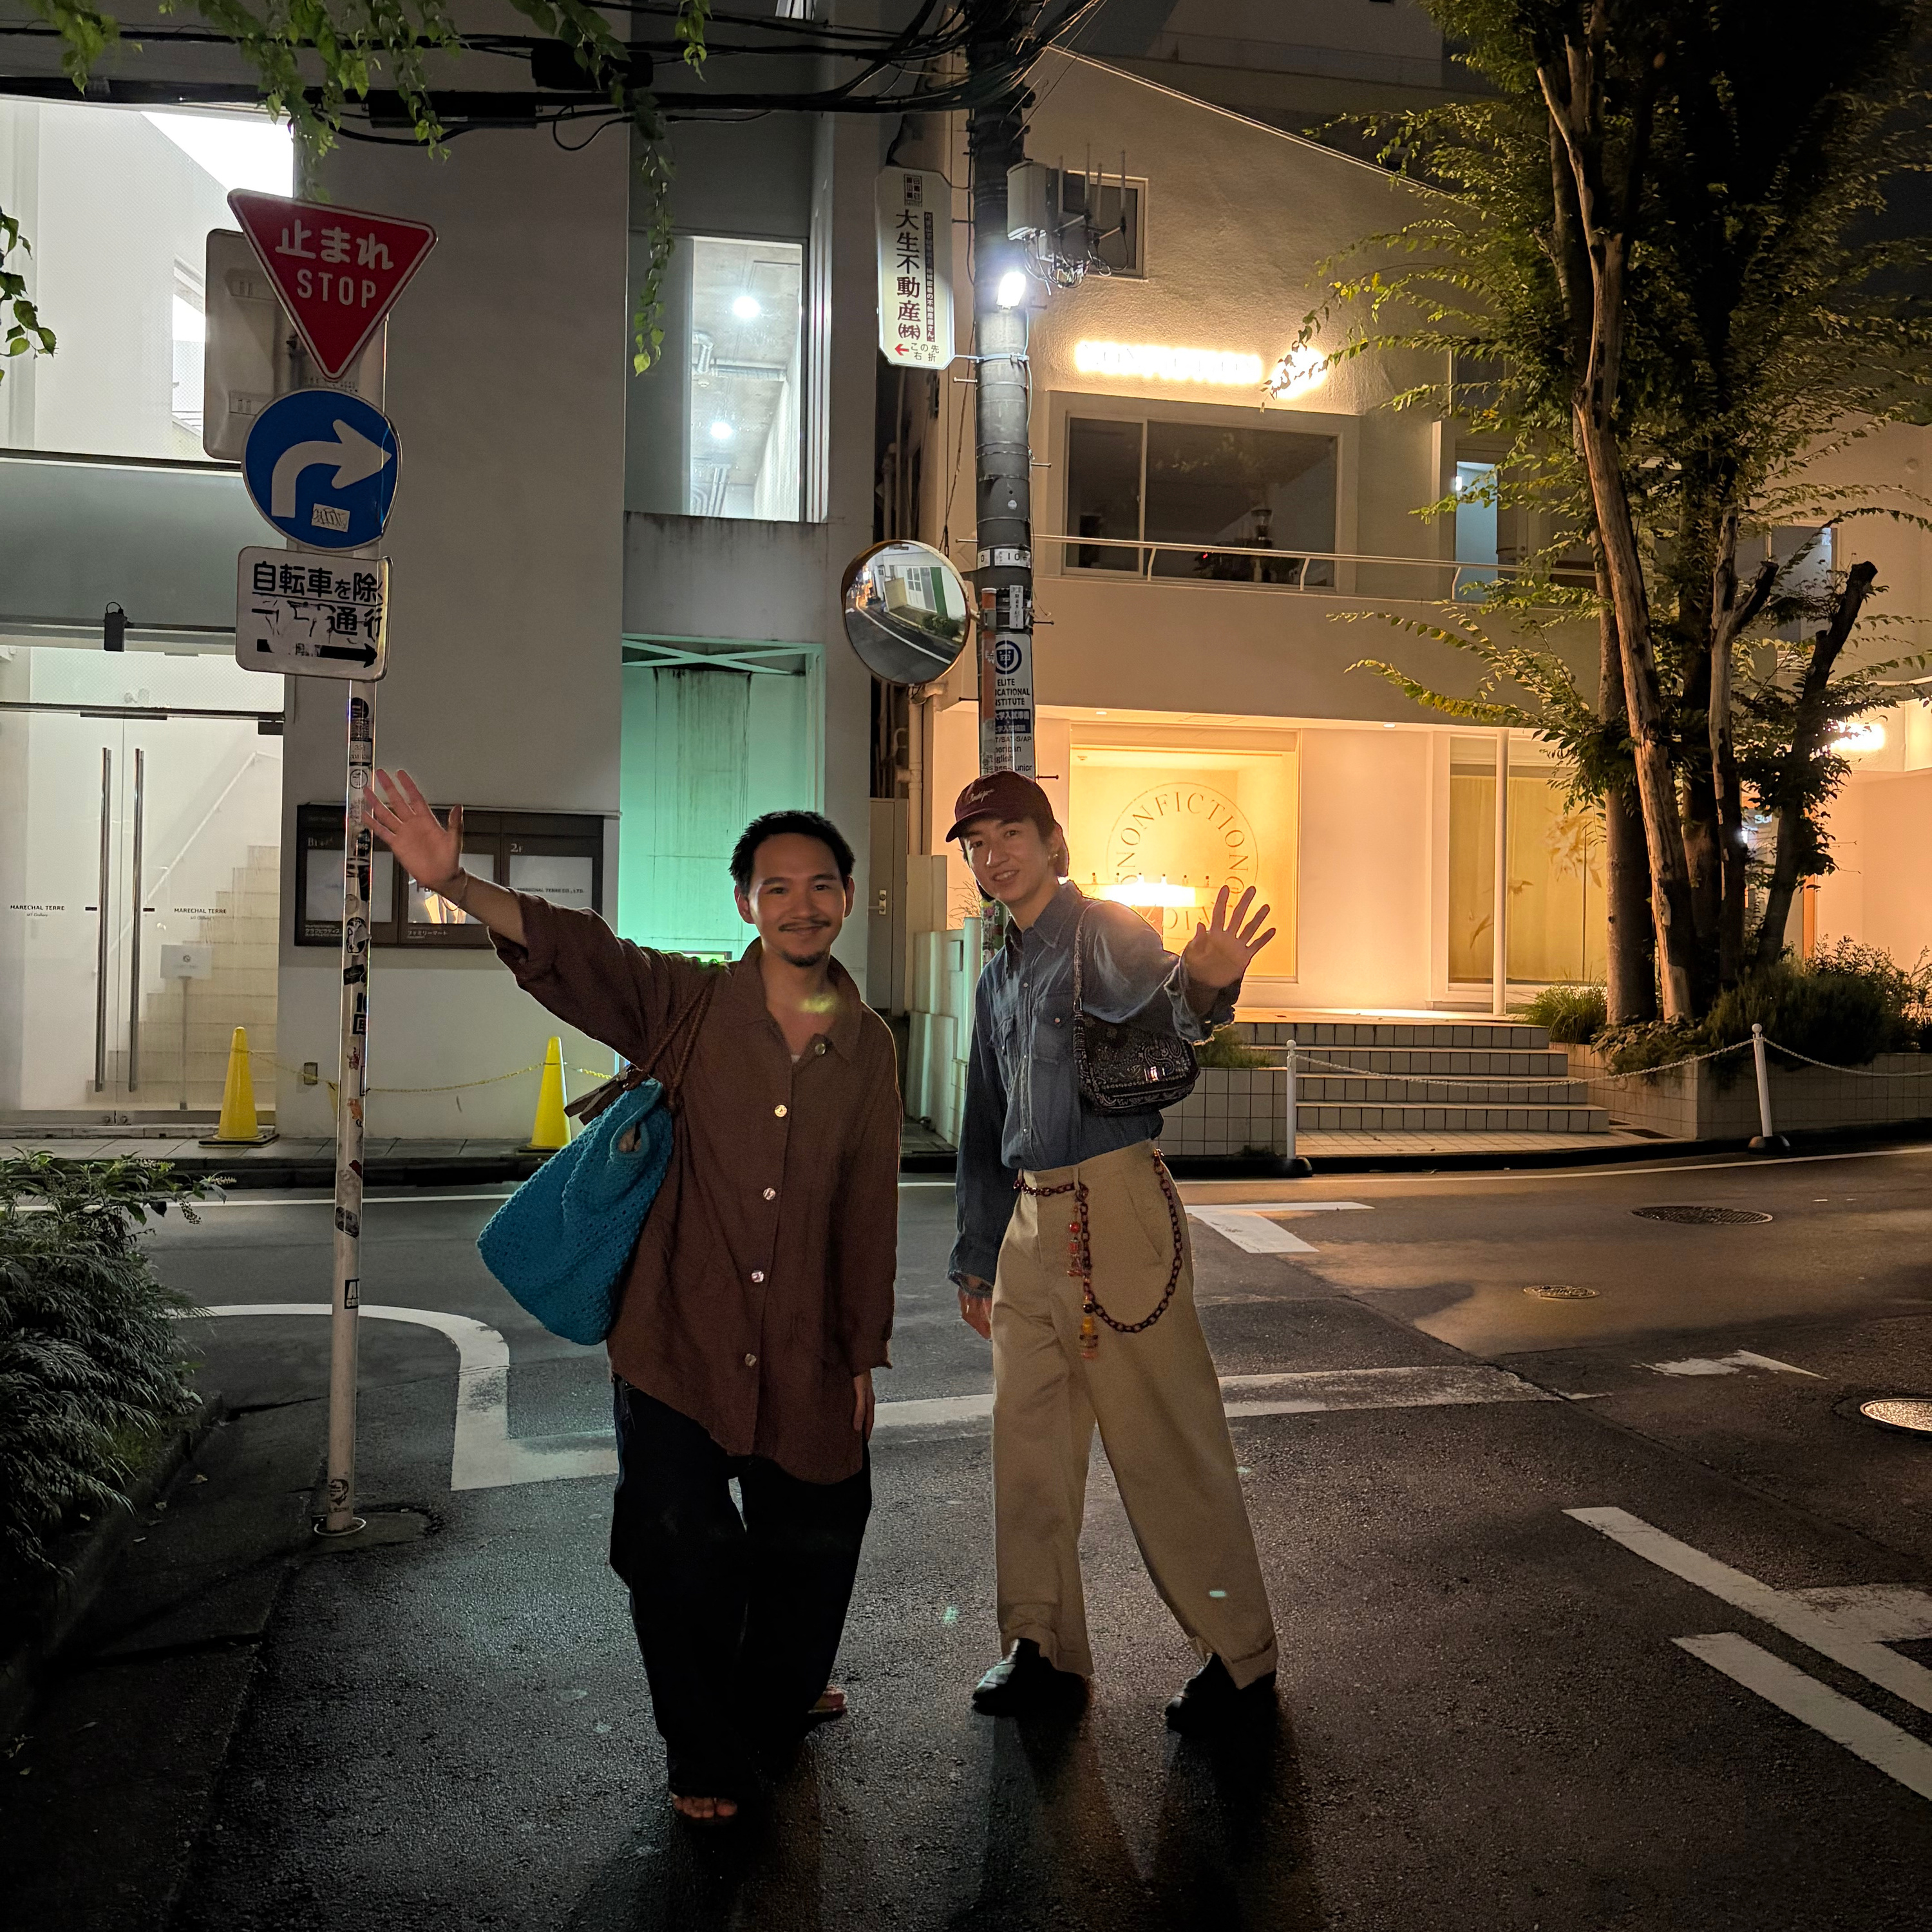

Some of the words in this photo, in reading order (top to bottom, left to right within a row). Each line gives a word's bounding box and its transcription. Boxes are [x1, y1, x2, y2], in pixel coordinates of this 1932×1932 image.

[274, 218, 394, 270] 止まれ
[297, 268, 377, 309] STOP
[910, 342, 940, 354] この先
[913, 351, 936, 363] 右折
[997, 678, 1016, 687] ELITE
[995, 688, 1030, 696] CATIONAL
[995, 697, 1025, 706] STITUTE
[1116, 791, 1249, 872] NONFICTION
